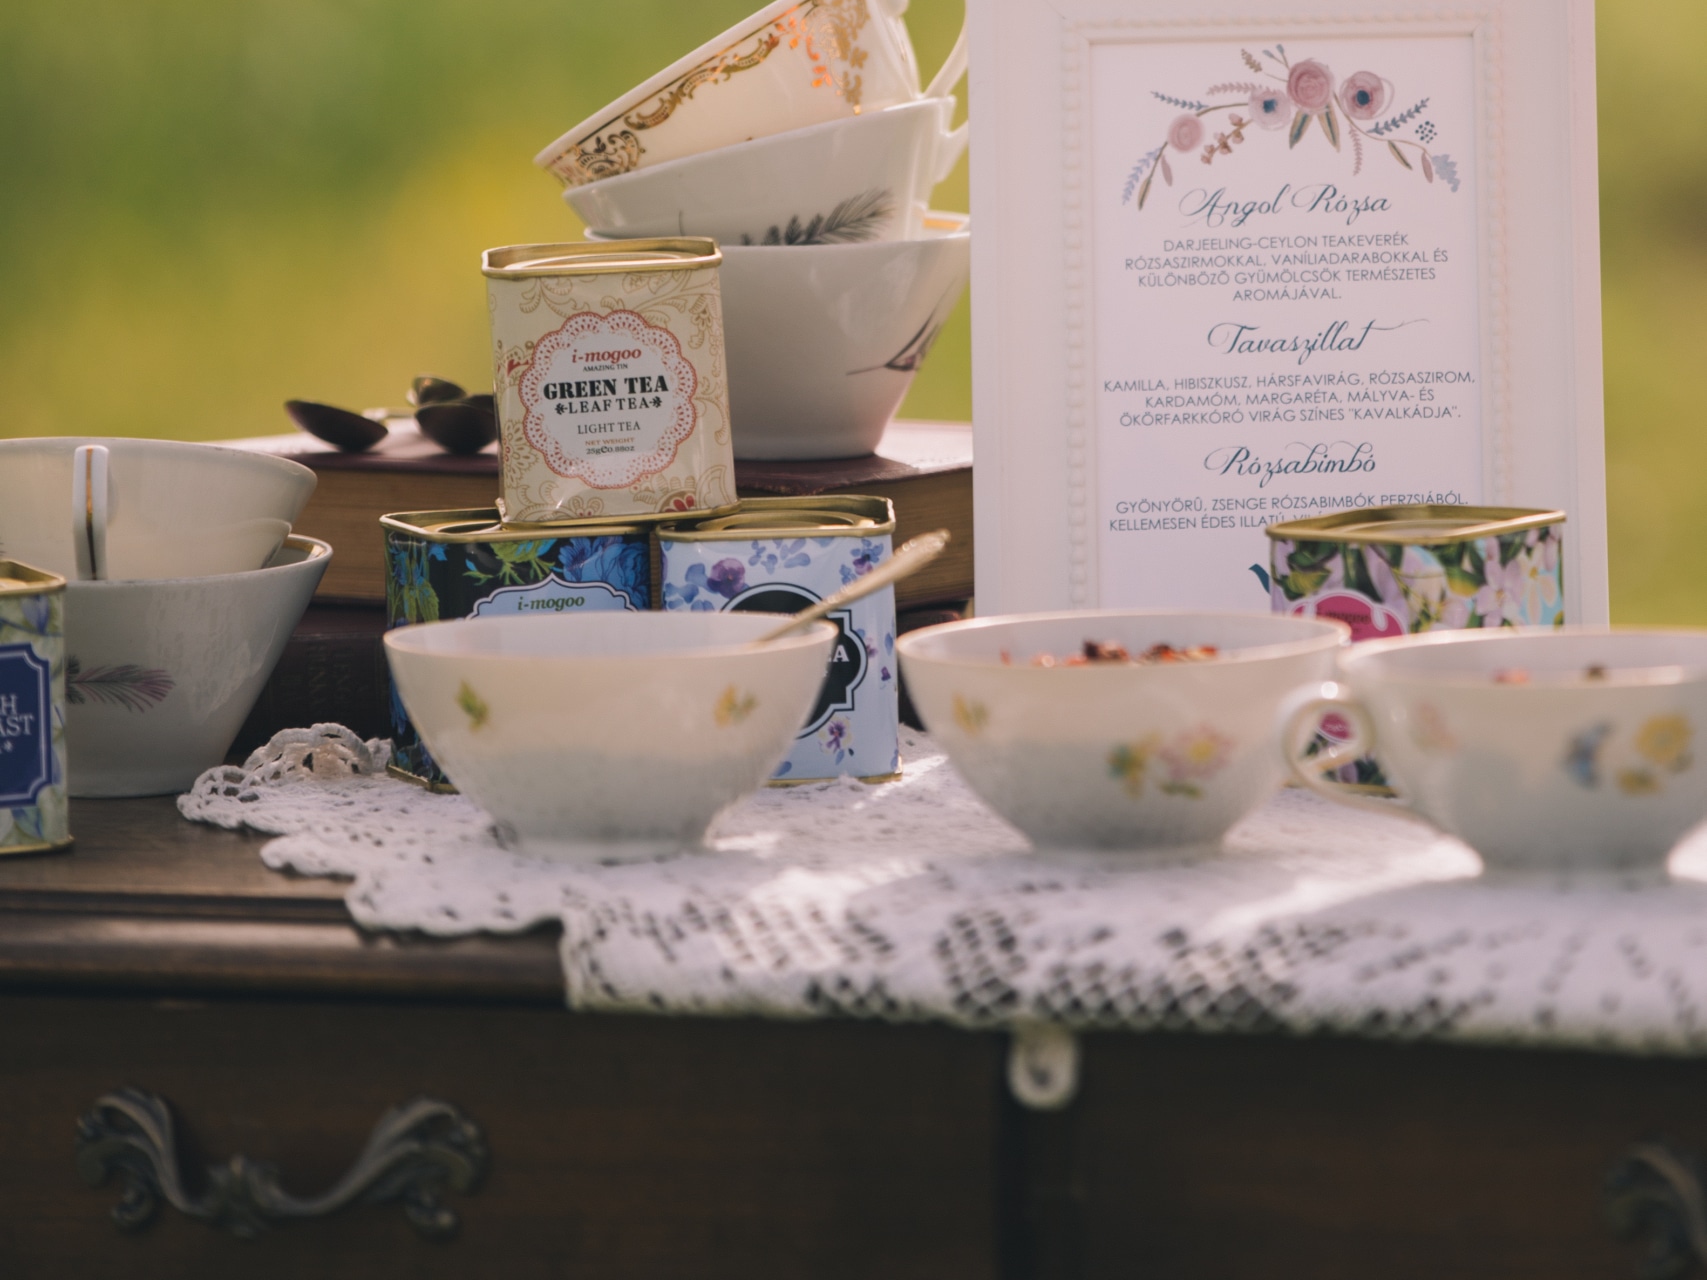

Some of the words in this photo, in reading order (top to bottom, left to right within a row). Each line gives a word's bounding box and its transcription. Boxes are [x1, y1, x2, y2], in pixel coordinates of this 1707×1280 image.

[1179, 183, 1290, 228] Angol
[1291, 183, 1392, 226] Rózsa
[1163, 235, 1318, 253] DARJEELING-CEYLON
[1321, 231, 1410, 248] TEAKEVERÉK
[1270, 250, 1429, 267] VANÍLIADARABOKKAL
[1433, 247, 1449, 263] ÉS
[1234, 268, 1342, 285] GYÜMÖLCSÖK
[1345, 265, 1436, 282] TERMÉSZETES
[1232, 285, 1342, 302] AROMÁJÁVAL.
[1207, 318, 1430, 366] Tavaszillat
[571, 348, 642, 365] i-mogoo
[582, 363, 615, 372] AMAZING
[616, 362, 628, 370] TIN
[543, 378, 617, 401] GREEN
[624, 374, 669, 395] TEA
[1103, 379, 1170, 393] KAMILLA,
[1174, 375, 1252, 391] HIBISZKUSZ,
[1256, 371, 1365, 388] HÁRSFAVIRÁG,
[1369, 369, 1476, 386] RÓZSASZIROM,
[568, 399, 612, 415] LEAF
[615, 397, 650, 411] TEA
[1145, 391, 1241, 409] KARDAMÓM,
[1245, 388, 1343, 405] MARGARÉTA,
[1347, 386, 1415, 403] MÁLYVA-
[1419, 386, 1435, 402] ÉS
[1119, 408, 1245, 428] ÖKÖRFARKKÓRÓ
[1248, 406, 1296, 423] VIRÁG
[1300, 405, 1345, 422] SZÍNES
[577, 422, 615, 435] LIGHT
[617, 421, 641, 432] TEA
[585, 439, 602, 447] NET
[602, 437, 635, 446] WEIGHT
[1203, 440, 1376, 489] Rózsabimbó
[1211, 497, 1267, 511] ZSENGE
[1271, 493, 1376, 510] RÓZSABIMBÓK
[1109, 517, 1197, 532] KELLEMESEN
[1201, 514, 1236, 529] ÉDES
[517, 595, 585, 612] i-mogoo
